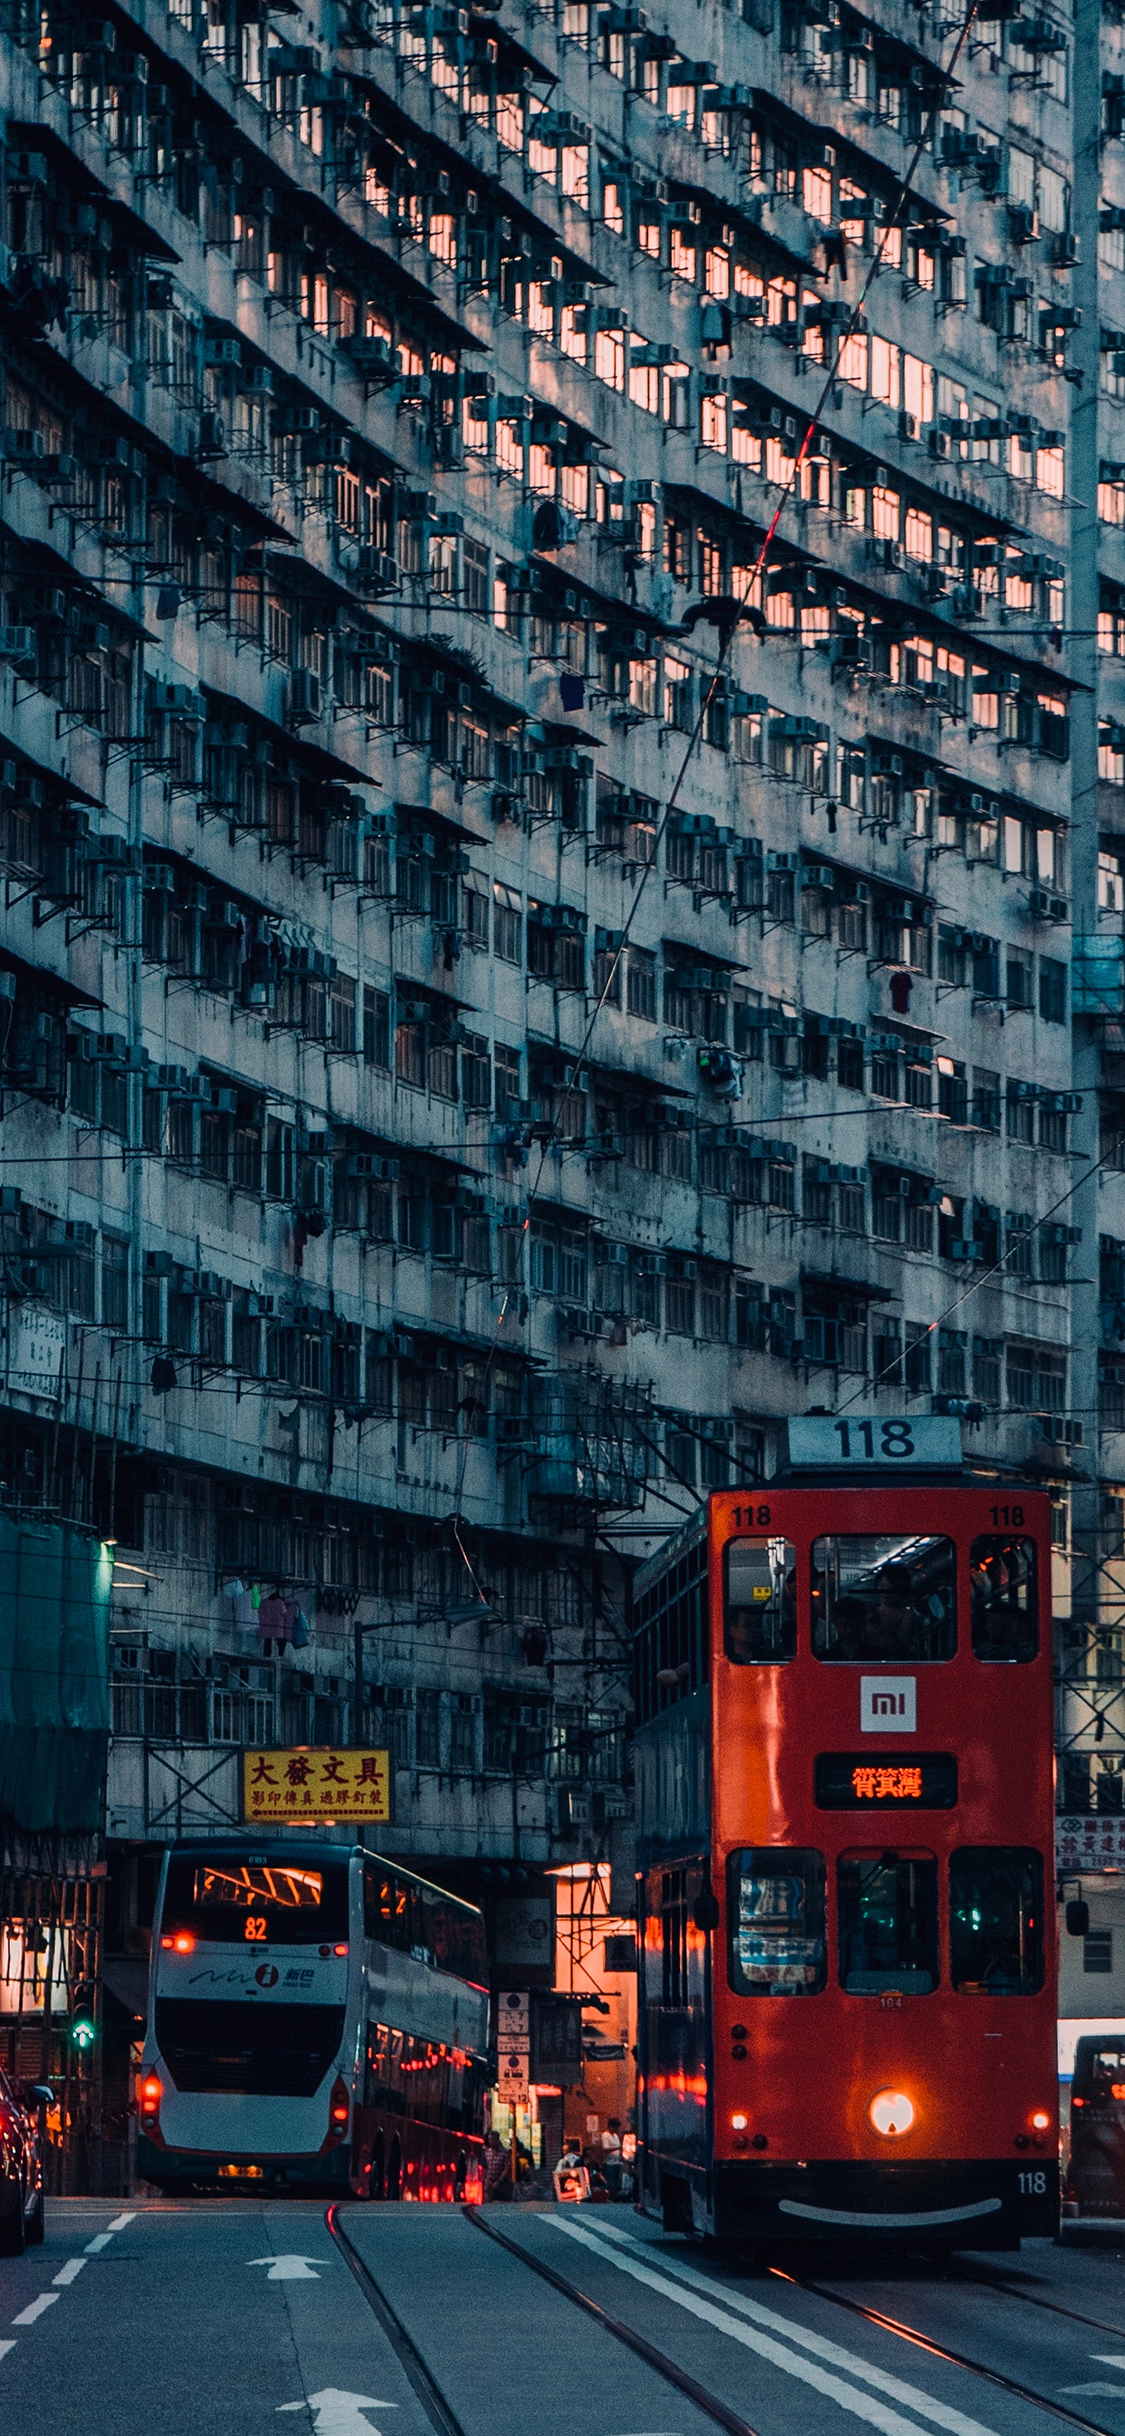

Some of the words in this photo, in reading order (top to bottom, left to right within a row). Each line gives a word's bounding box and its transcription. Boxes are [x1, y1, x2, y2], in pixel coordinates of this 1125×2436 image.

[834, 1419, 914, 1458] 118
[732, 1505, 772, 1527] 118
[989, 1505, 1025, 1528] 118
[250, 1756, 384, 1787] 大發文具
[244, 1916, 268, 1941] 82
[880, 1997, 902, 2008] 104
[1017, 2172, 1047, 2194] 118
